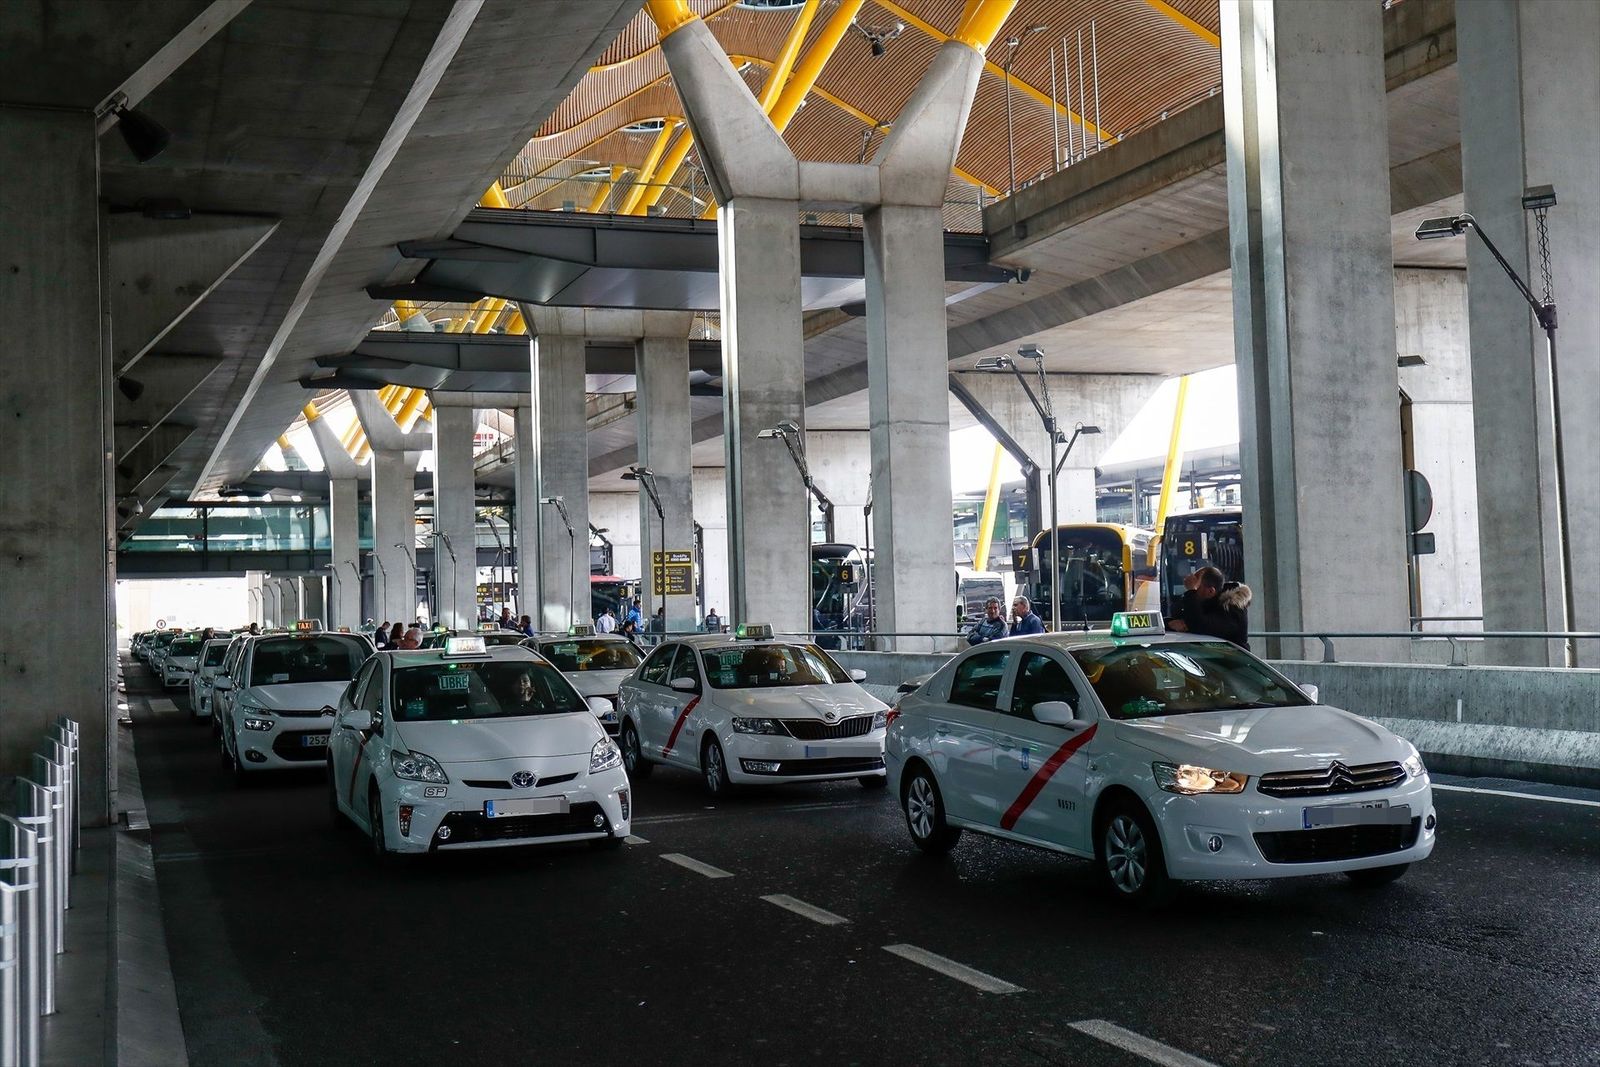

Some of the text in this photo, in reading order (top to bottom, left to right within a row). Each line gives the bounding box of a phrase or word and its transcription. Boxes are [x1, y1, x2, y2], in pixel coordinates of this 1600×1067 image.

[1184, 541, 1195, 555] 8
[1018, 555, 1027, 568] 7
[841, 570, 849, 580] 6
[620, 588, 625, 596] 3
[297, 622, 312, 630] TAXI
[1127, 615, 1149, 628] TAXI
[747, 627, 764, 636] TAXI
[441, 675, 468, 689] LIBRE
[427, 788, 445, 796] SP
